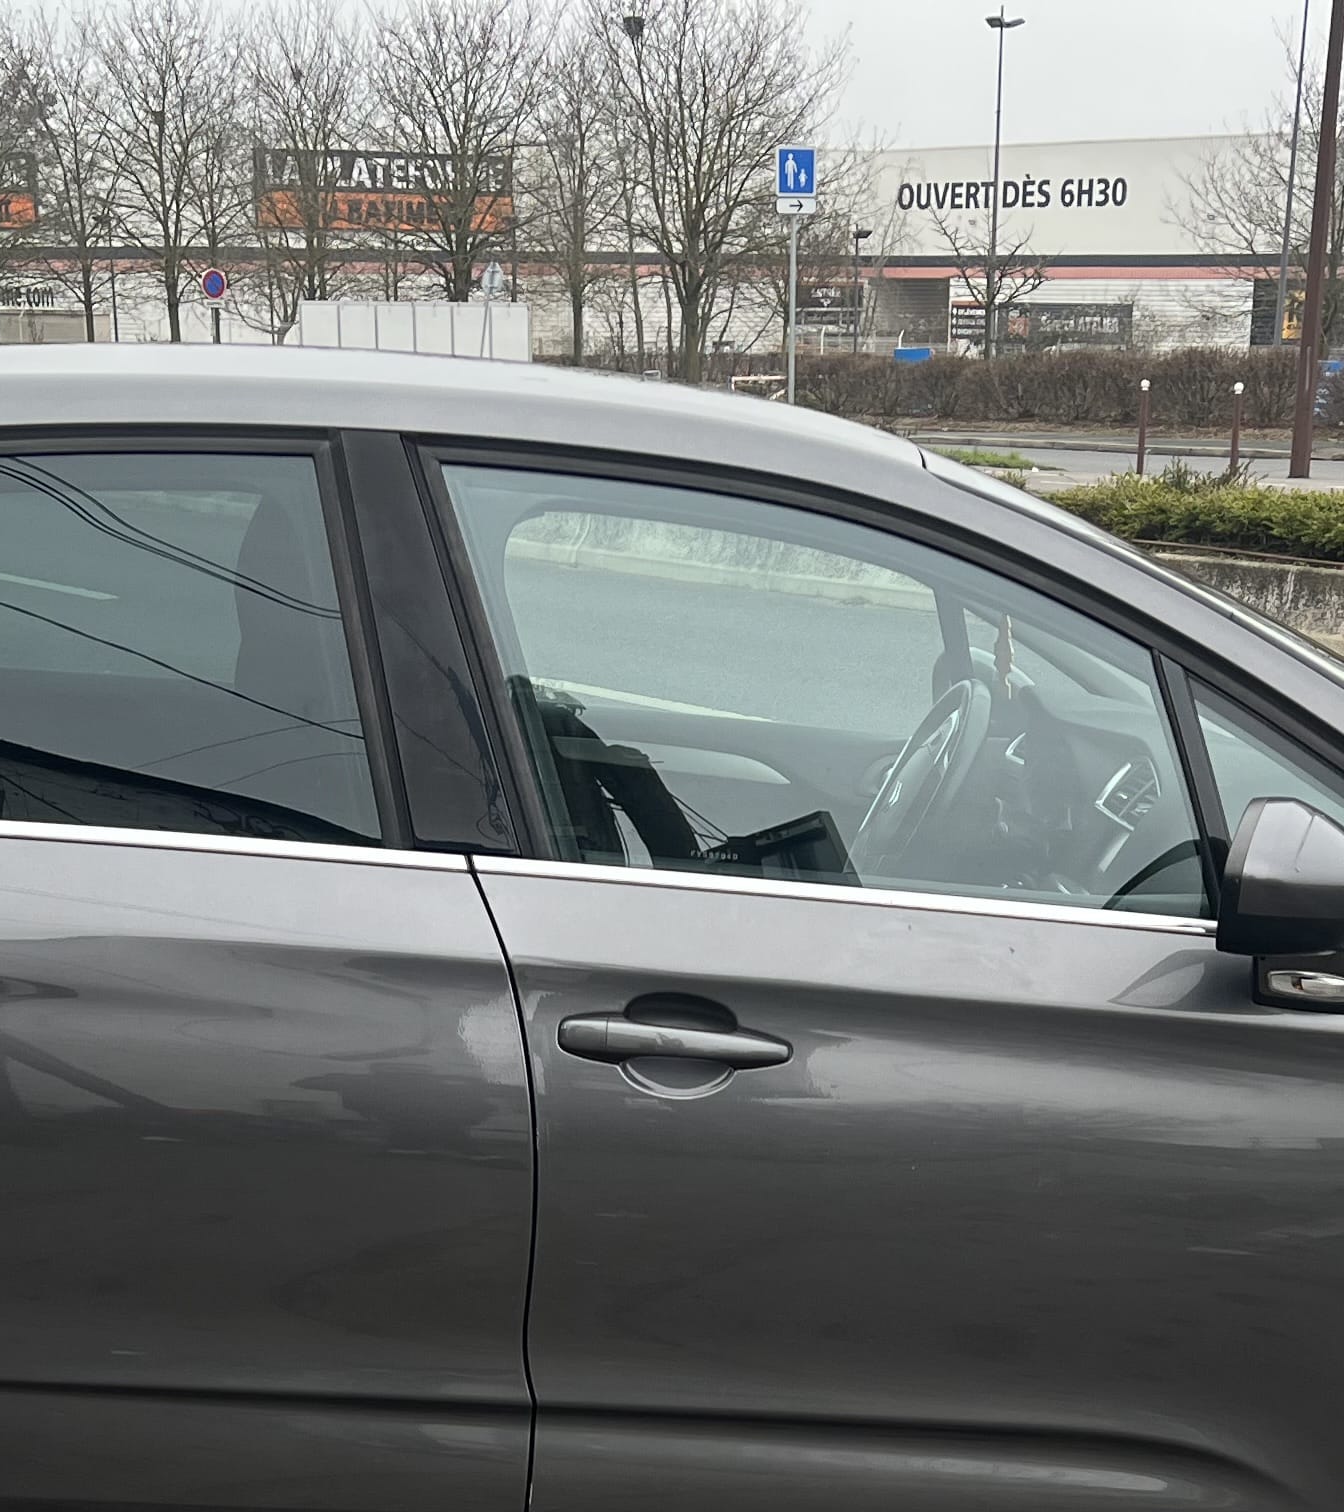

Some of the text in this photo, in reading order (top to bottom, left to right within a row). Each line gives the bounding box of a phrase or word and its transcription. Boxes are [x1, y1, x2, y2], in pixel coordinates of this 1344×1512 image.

[897, 174, 1128, 210] OUVERT DÈS 6H30
